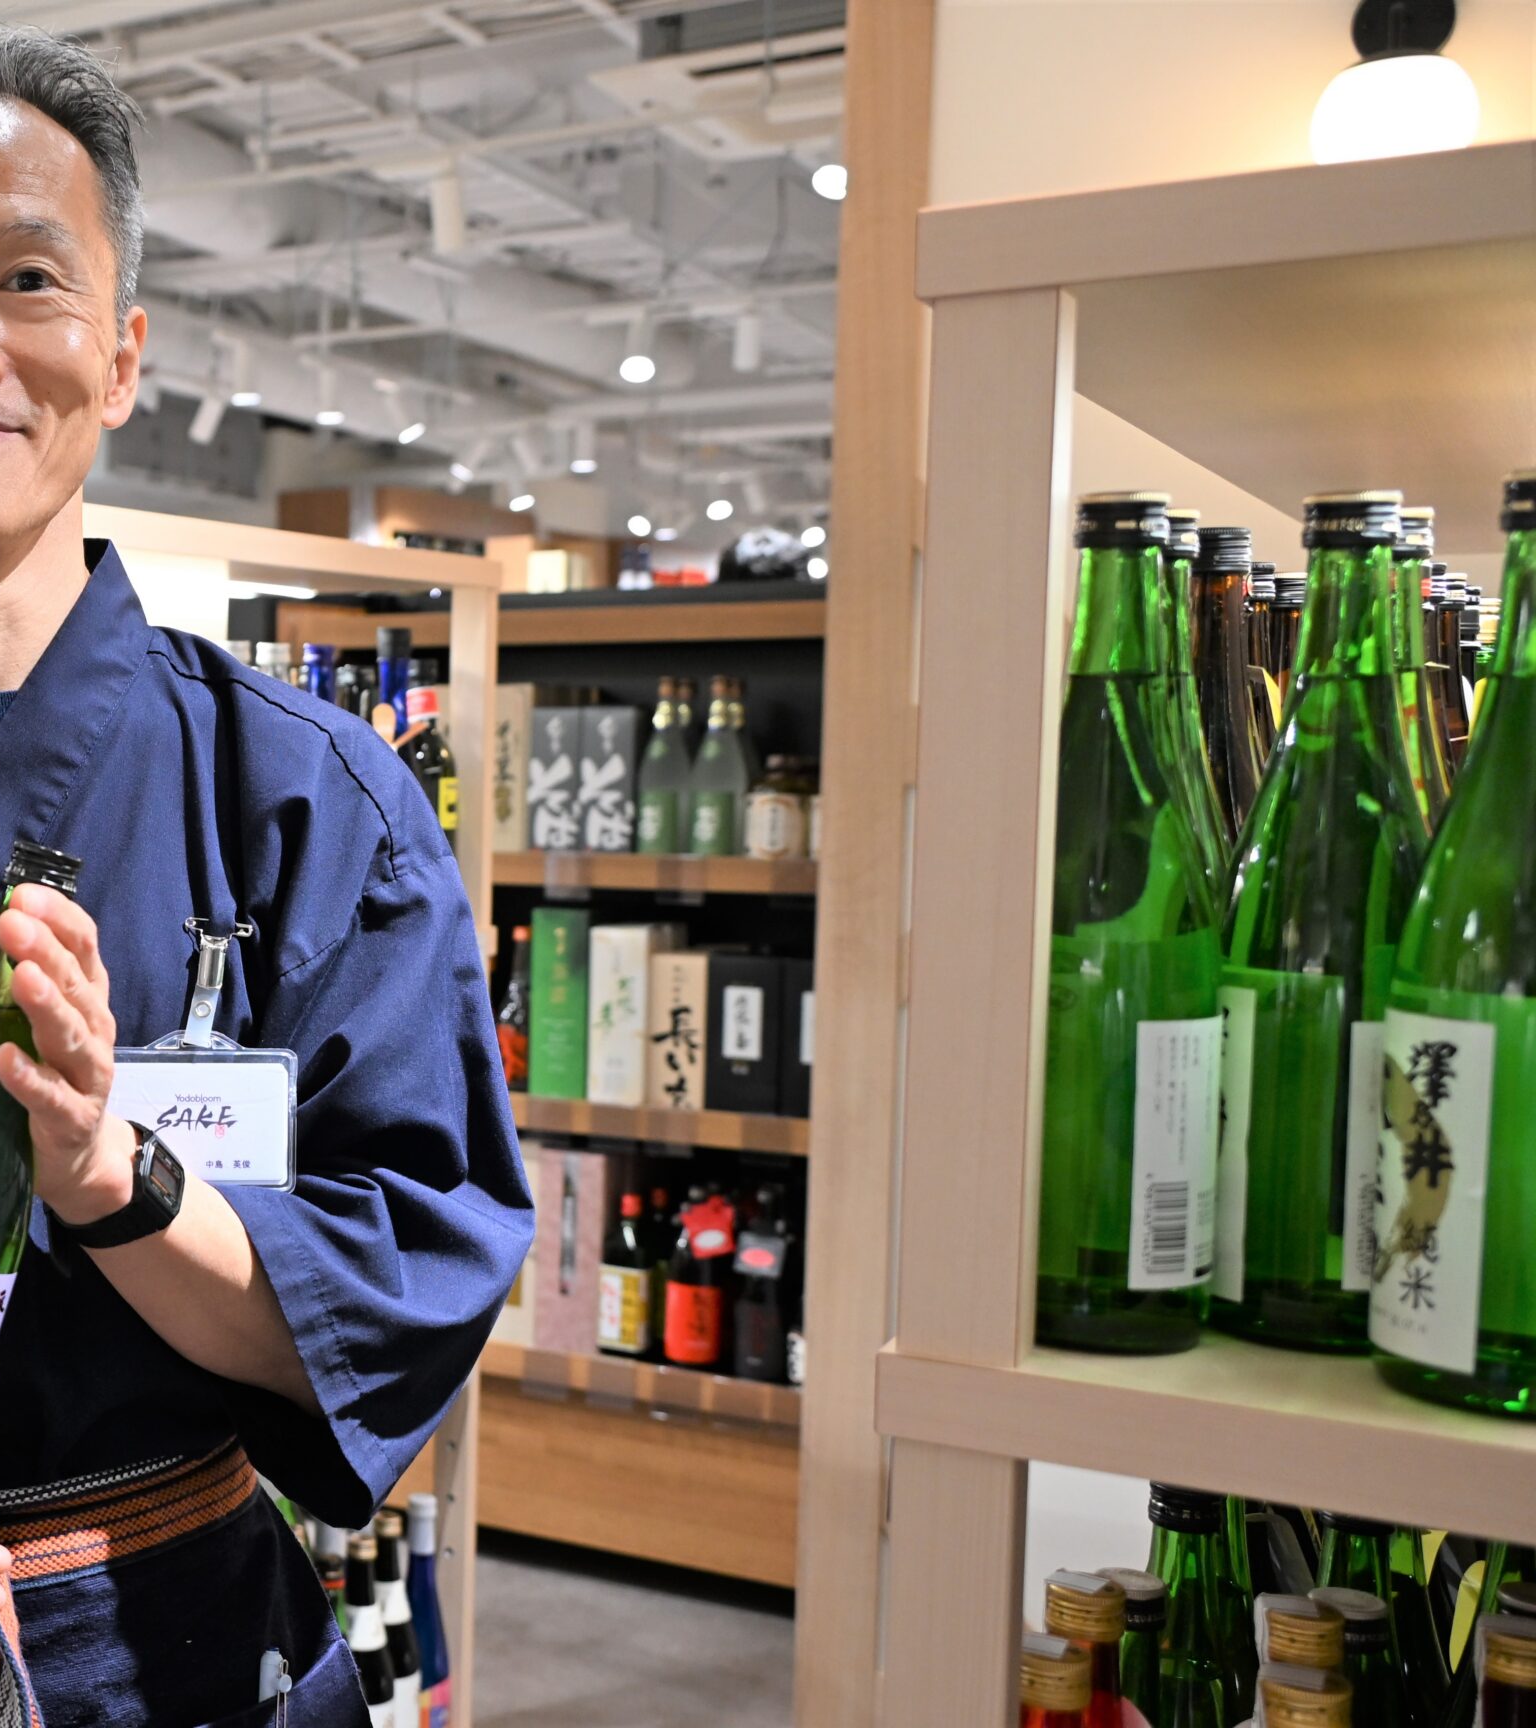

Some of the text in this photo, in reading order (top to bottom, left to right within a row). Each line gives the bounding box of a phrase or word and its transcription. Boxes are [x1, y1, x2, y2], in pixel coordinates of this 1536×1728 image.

[175, 1093, 221, 1103] Yodobloom
[156, 1104, 237, 1132] SAKE
[1404, 1041, 1459, 1190] 澤乃井
